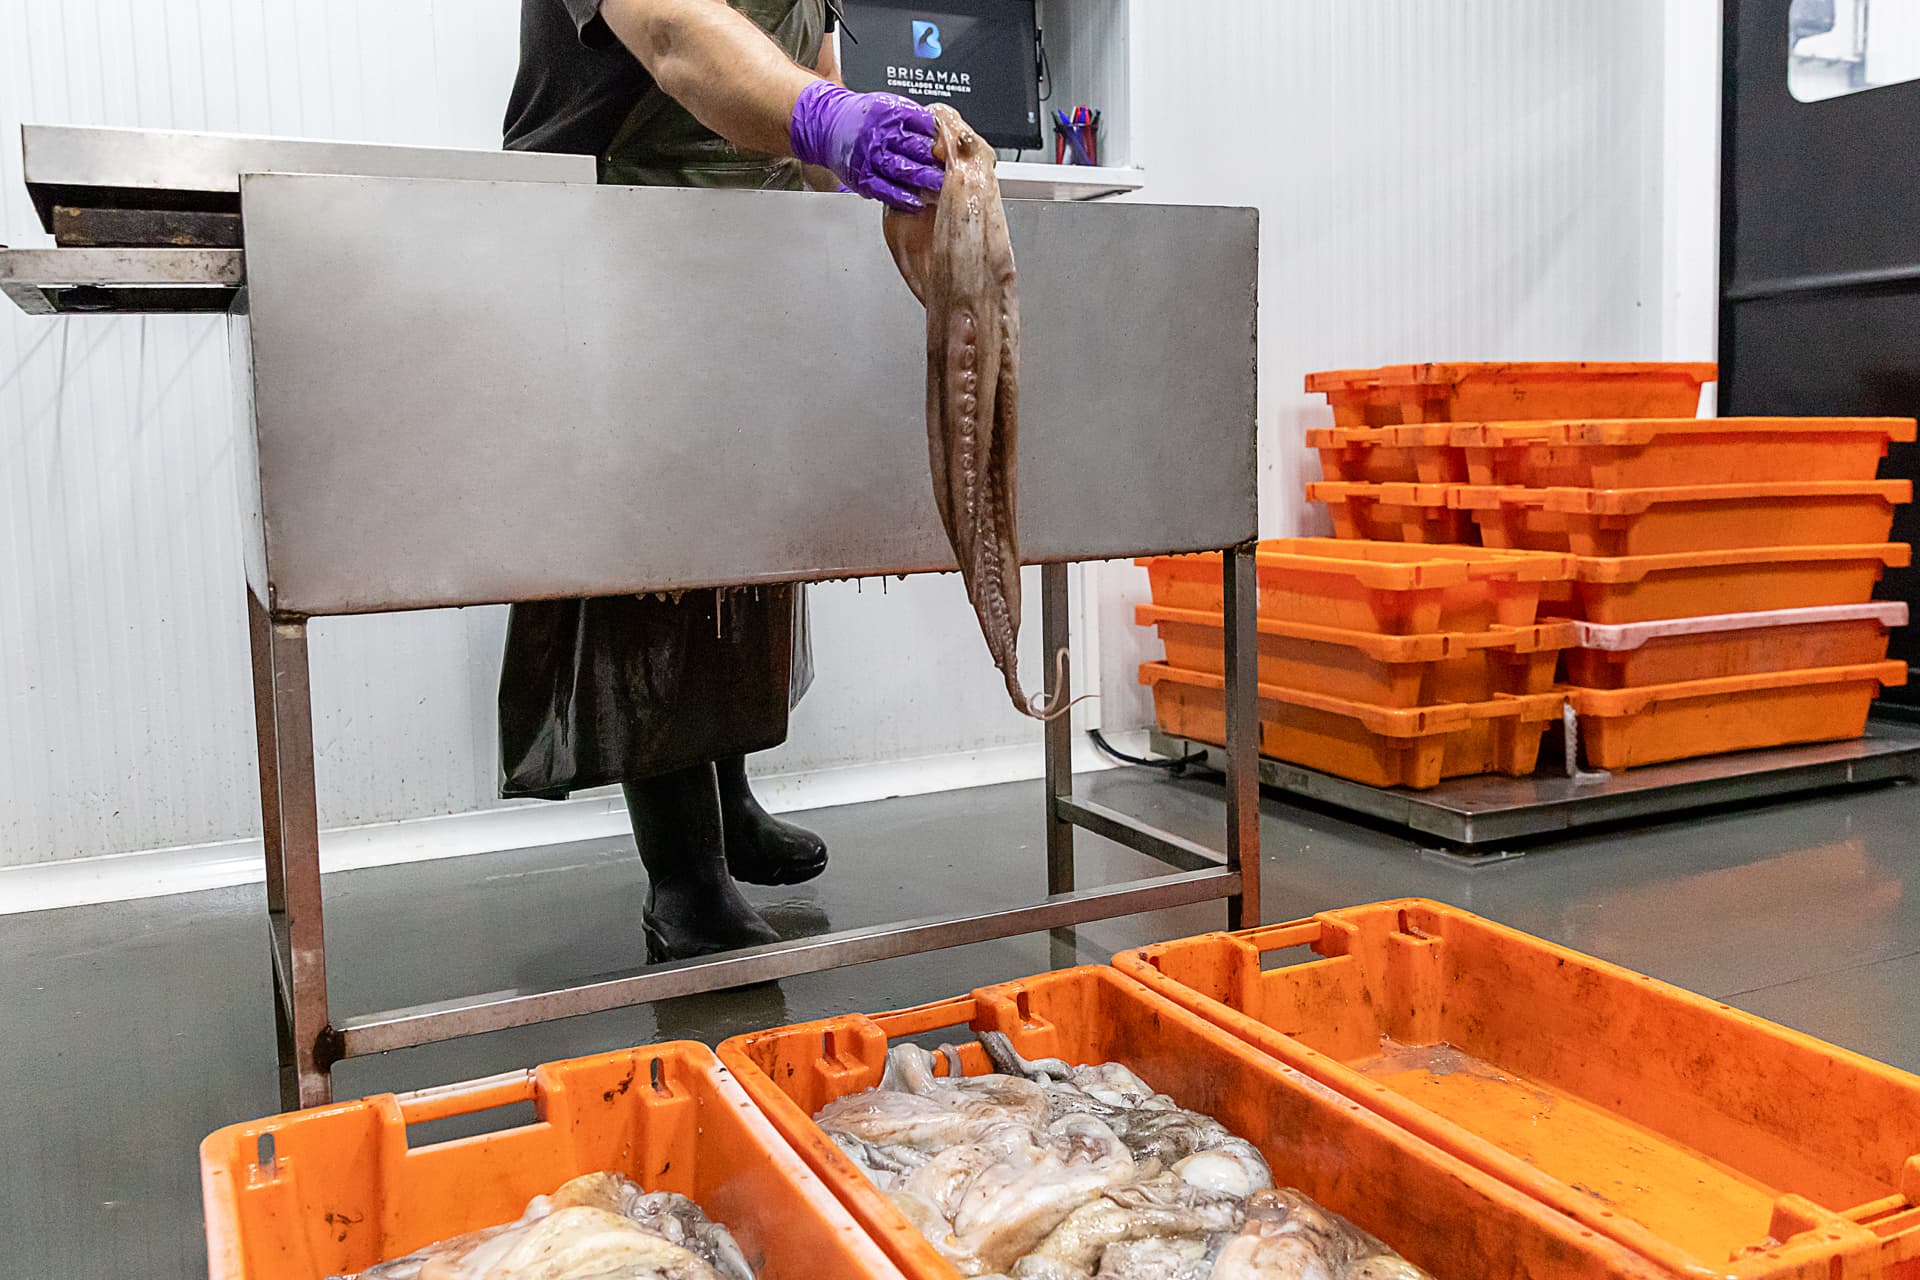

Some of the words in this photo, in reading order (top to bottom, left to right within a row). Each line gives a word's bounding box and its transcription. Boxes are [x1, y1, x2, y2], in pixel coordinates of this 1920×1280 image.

[886, 66, 971, 85] BRISAMAR
[887, 79, 933, 89] CONGELADOS
[934, 83, 944, 91] EN
[945, 84, 972, 93] ORIGEN
